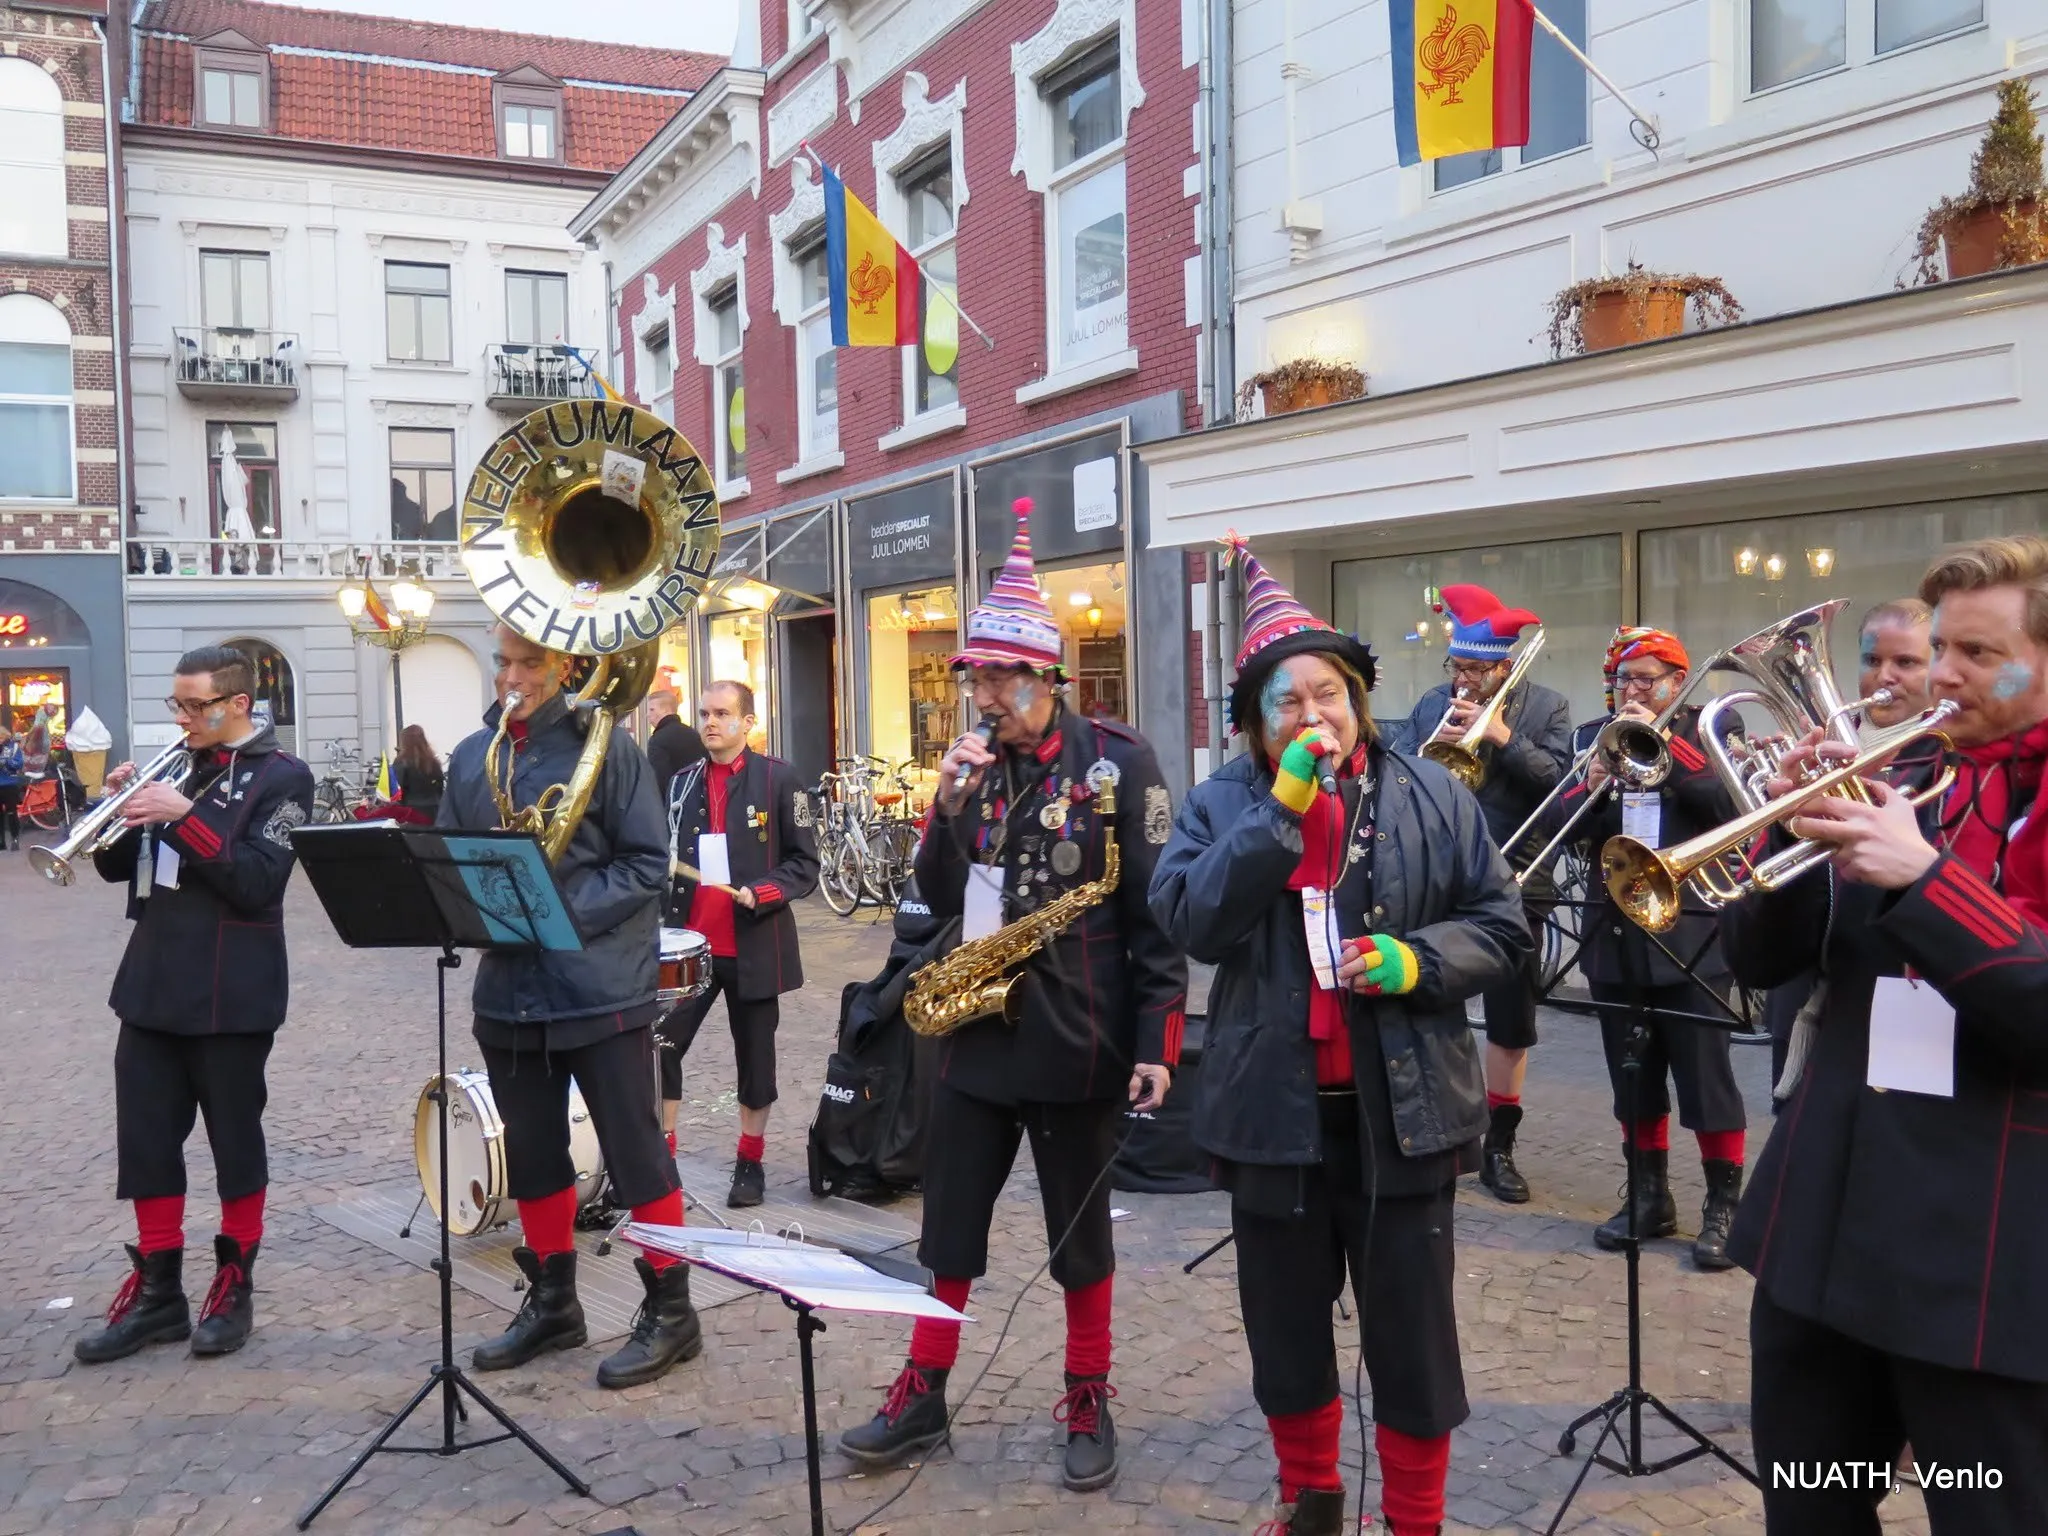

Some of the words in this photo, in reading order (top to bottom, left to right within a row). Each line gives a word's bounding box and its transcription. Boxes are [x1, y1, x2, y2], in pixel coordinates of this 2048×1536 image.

[1066, 327, 1088, 346] JUUL
[463, 419, 542, 551] NEET
[546, 400, 635, 448] UM
[635, 426, 720, 531] AAN
[871, 542, 892, 559] JUUL
[892, 533, 930, 555] LOMMEN
[479, 560, 549, 634] TE
